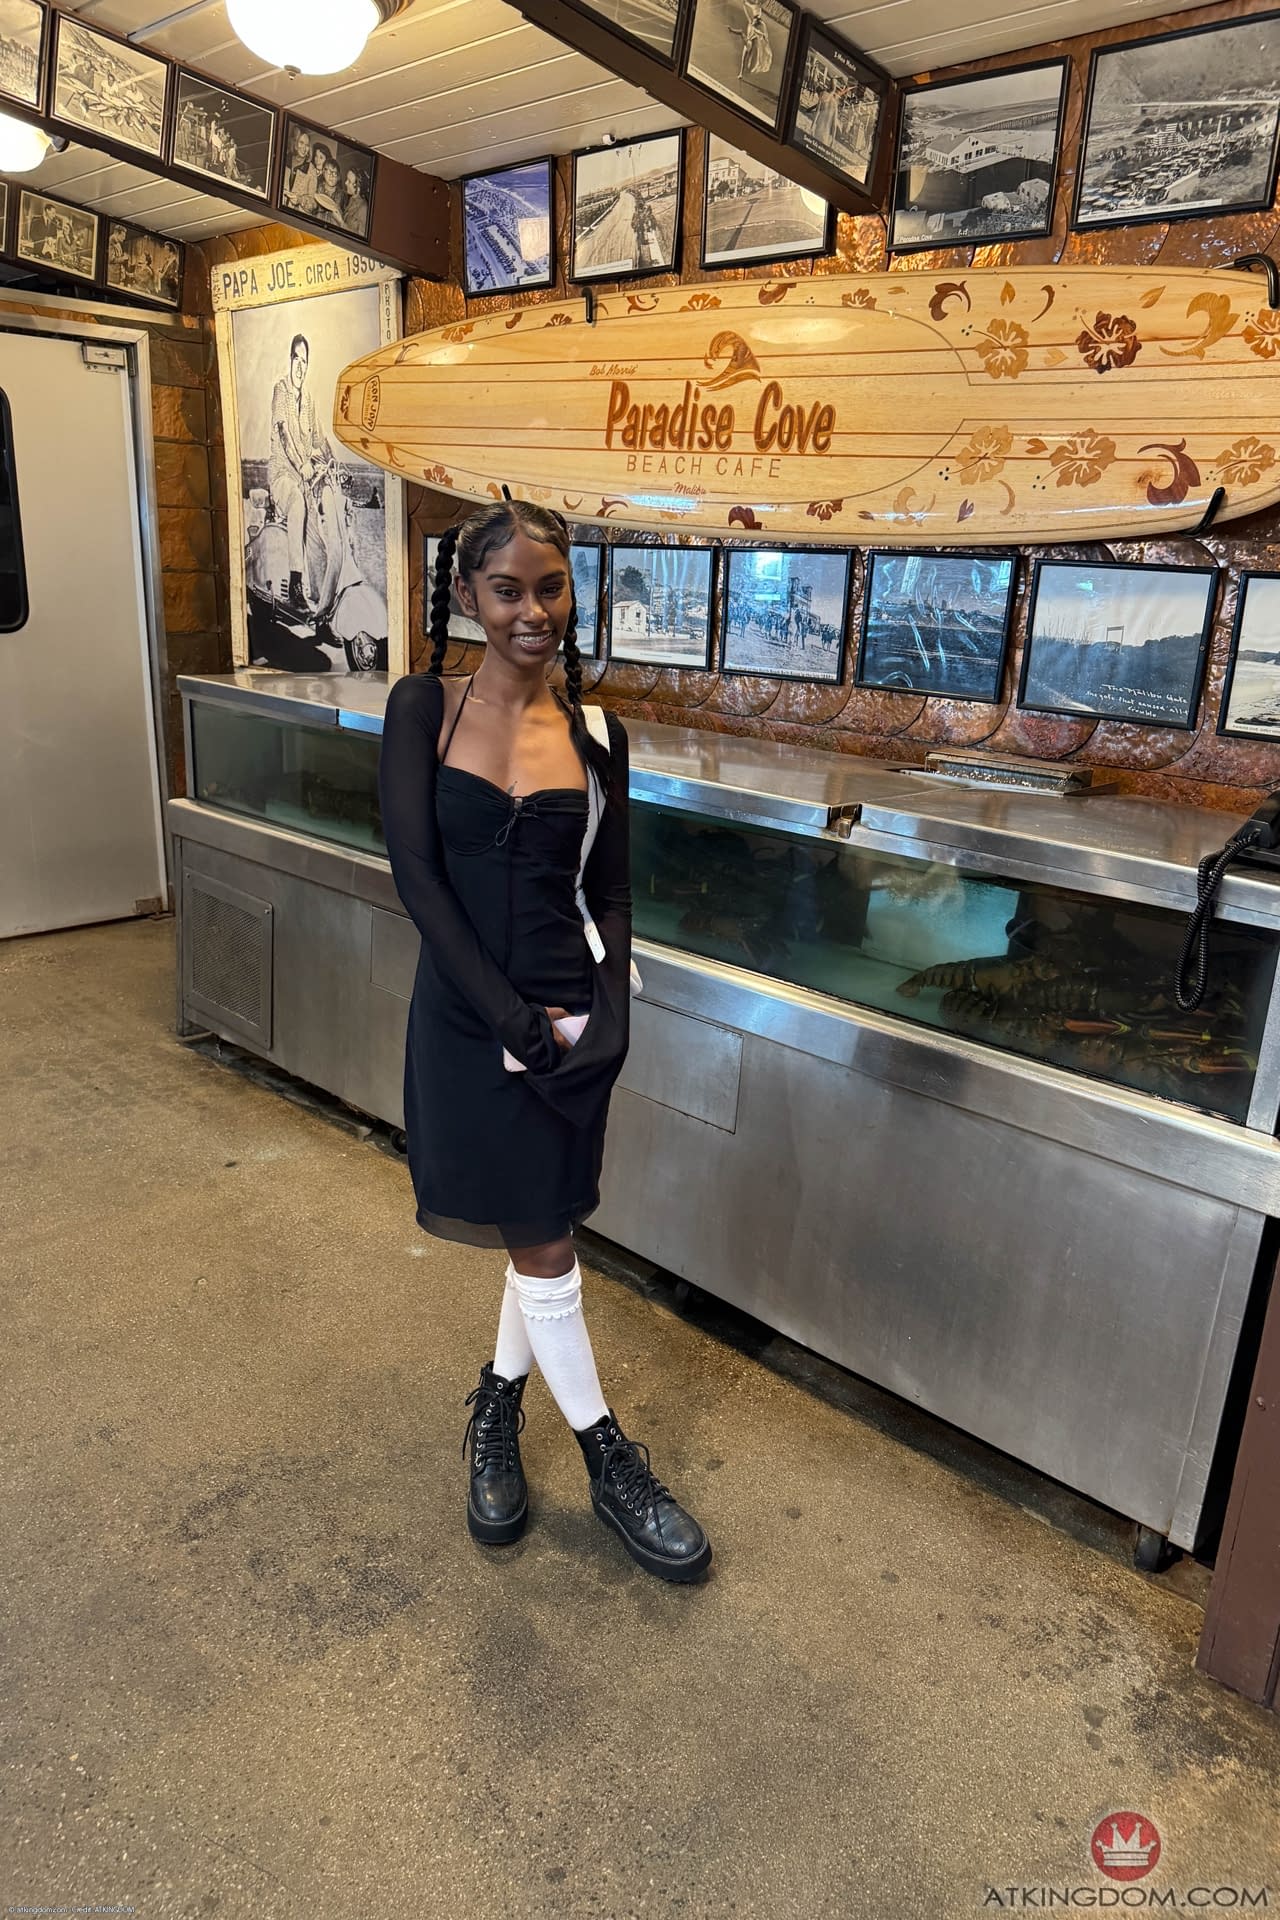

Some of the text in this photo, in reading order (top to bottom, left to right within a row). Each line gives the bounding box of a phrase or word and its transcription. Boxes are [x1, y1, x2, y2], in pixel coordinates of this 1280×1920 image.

[222, 269, 258, 300] PAPA
[267, 260, 302, 291] JOE.
[306, 259, 340, 285] CIRCA
[370, 380, 378, 402] RON
[367, 404, 377, 428] JON
[605, 379, 836, 454] Paradise Cove
[626, 454, 782, 479] BEACH CAFE
[674, 482, 707, 495] Malibu
